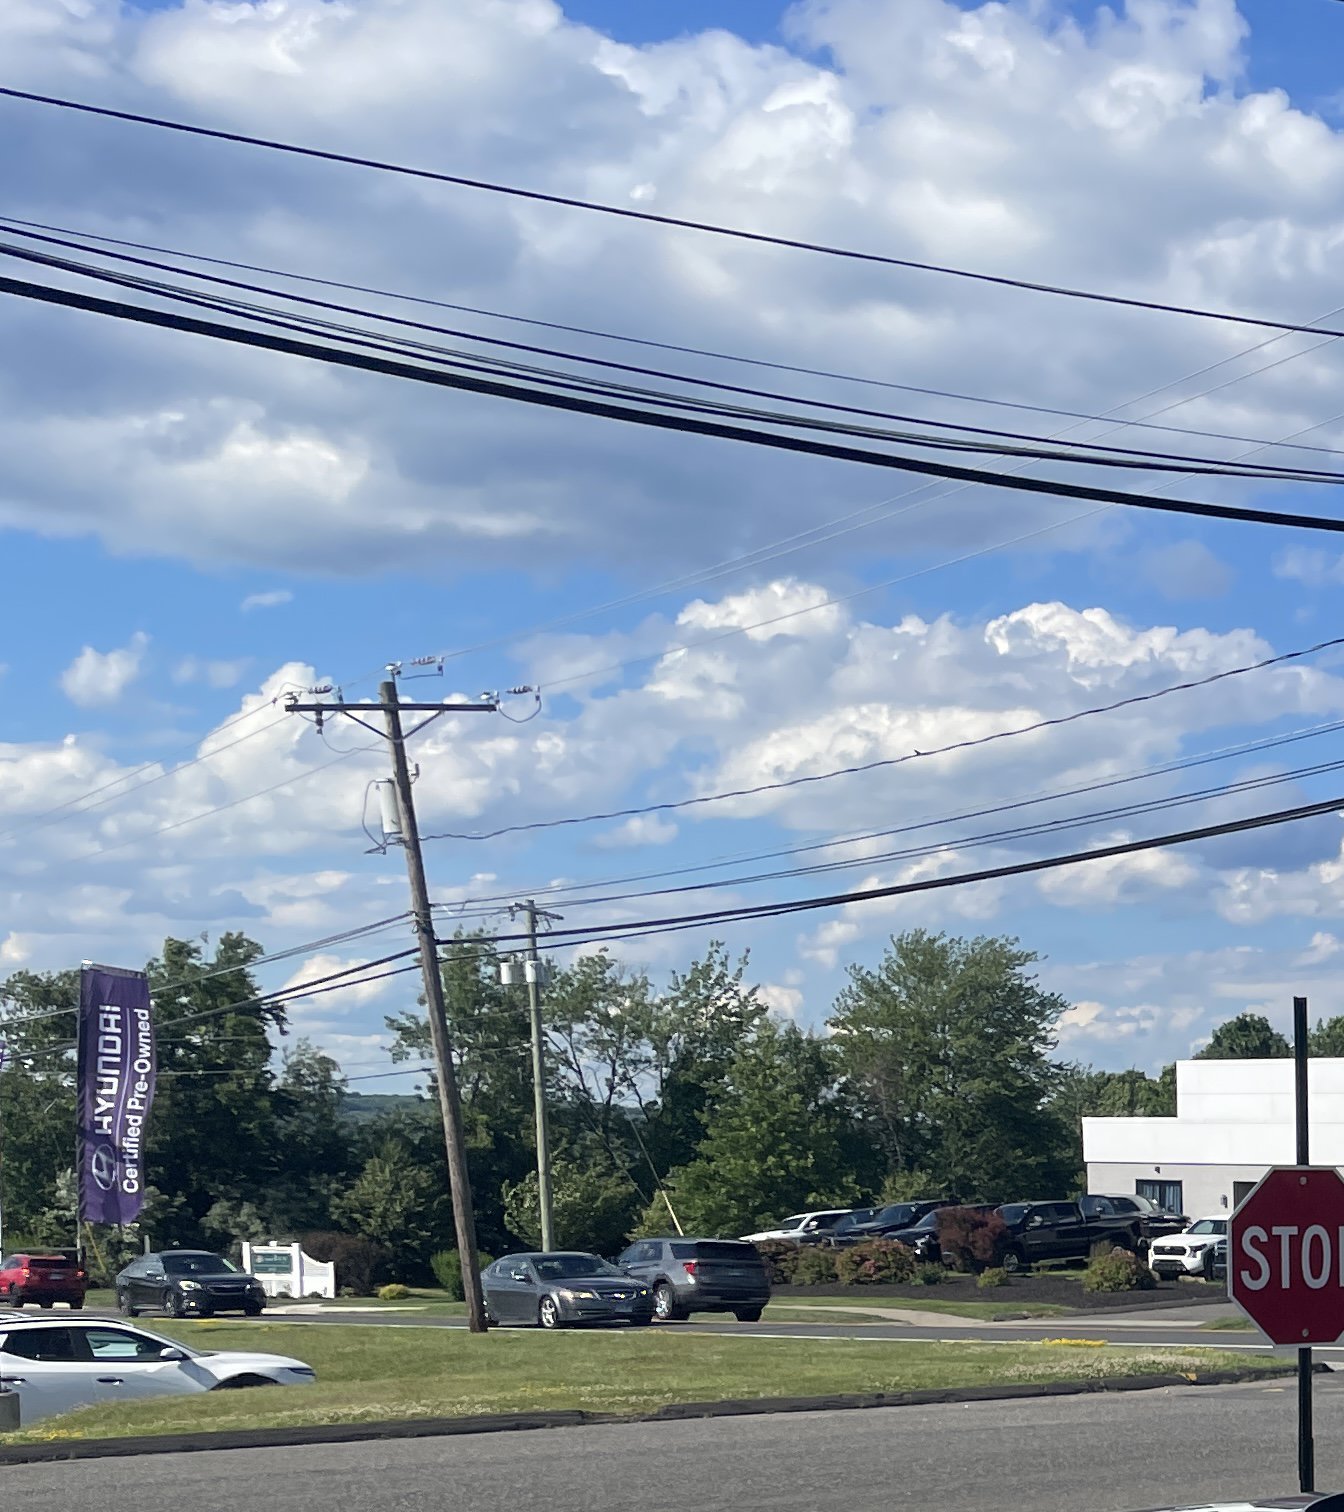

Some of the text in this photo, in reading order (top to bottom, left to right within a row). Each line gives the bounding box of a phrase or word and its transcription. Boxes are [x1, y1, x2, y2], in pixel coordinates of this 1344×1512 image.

[94, 1004, 121, 1135] HYUNDAI
[122, 1008, 151, 1194] Certified Pre-Owned
